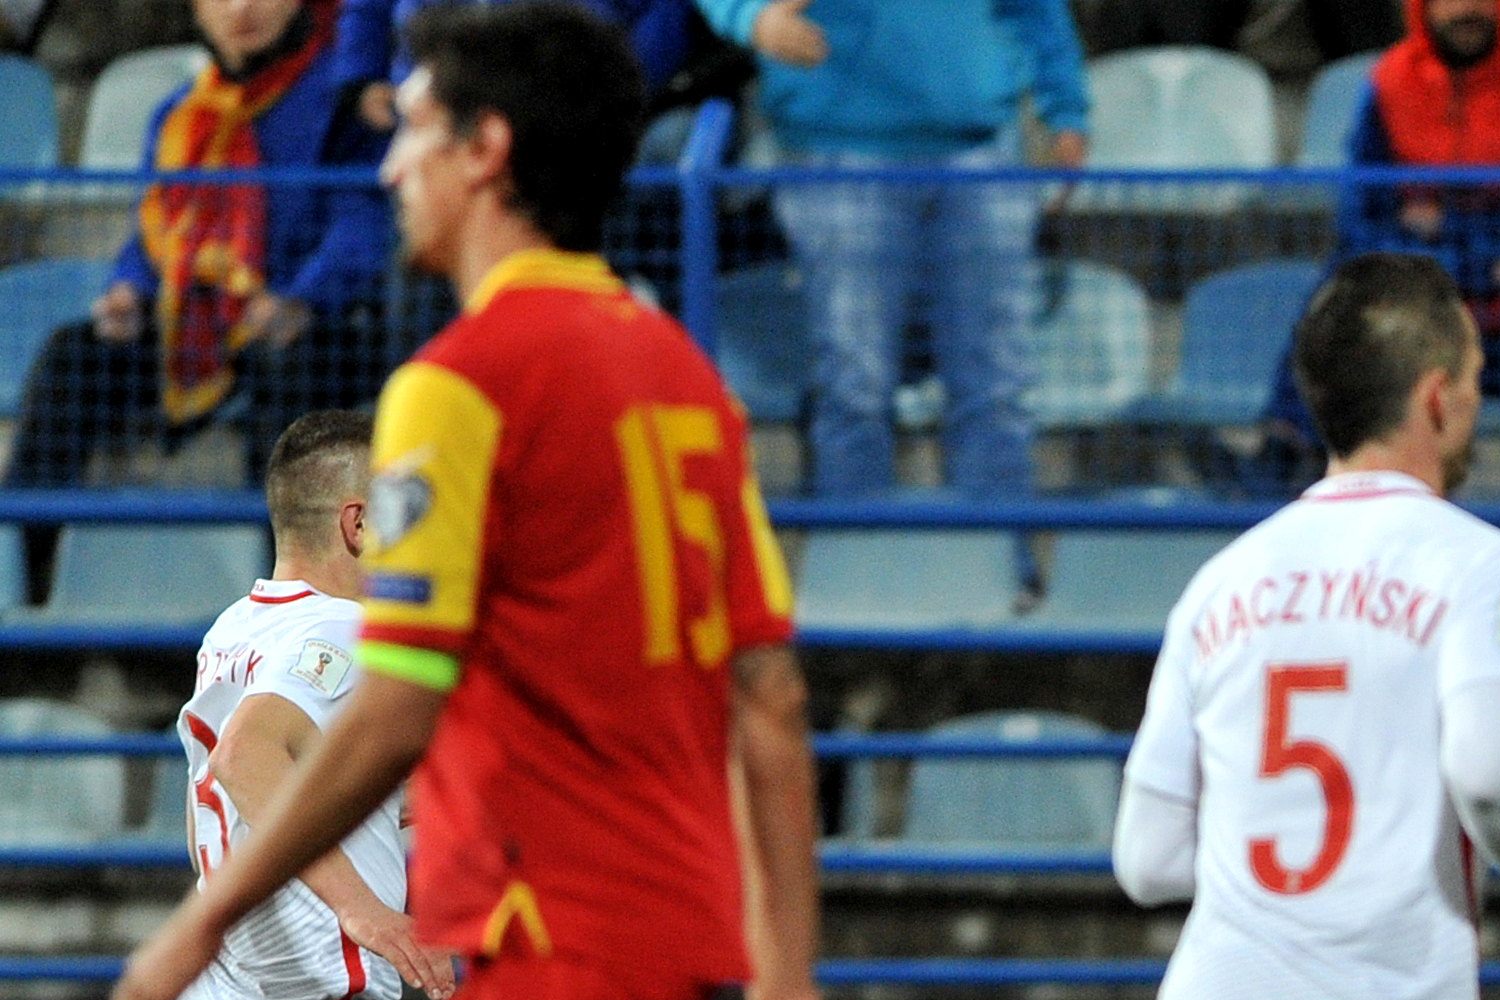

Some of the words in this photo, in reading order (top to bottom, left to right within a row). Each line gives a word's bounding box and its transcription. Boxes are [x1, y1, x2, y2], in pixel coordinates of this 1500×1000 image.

[614, 403, 730, 668] 15
[1191, 558, 1451, 664] MĄCZYŃSKI
[1246, 657, 1354, 896] 5
